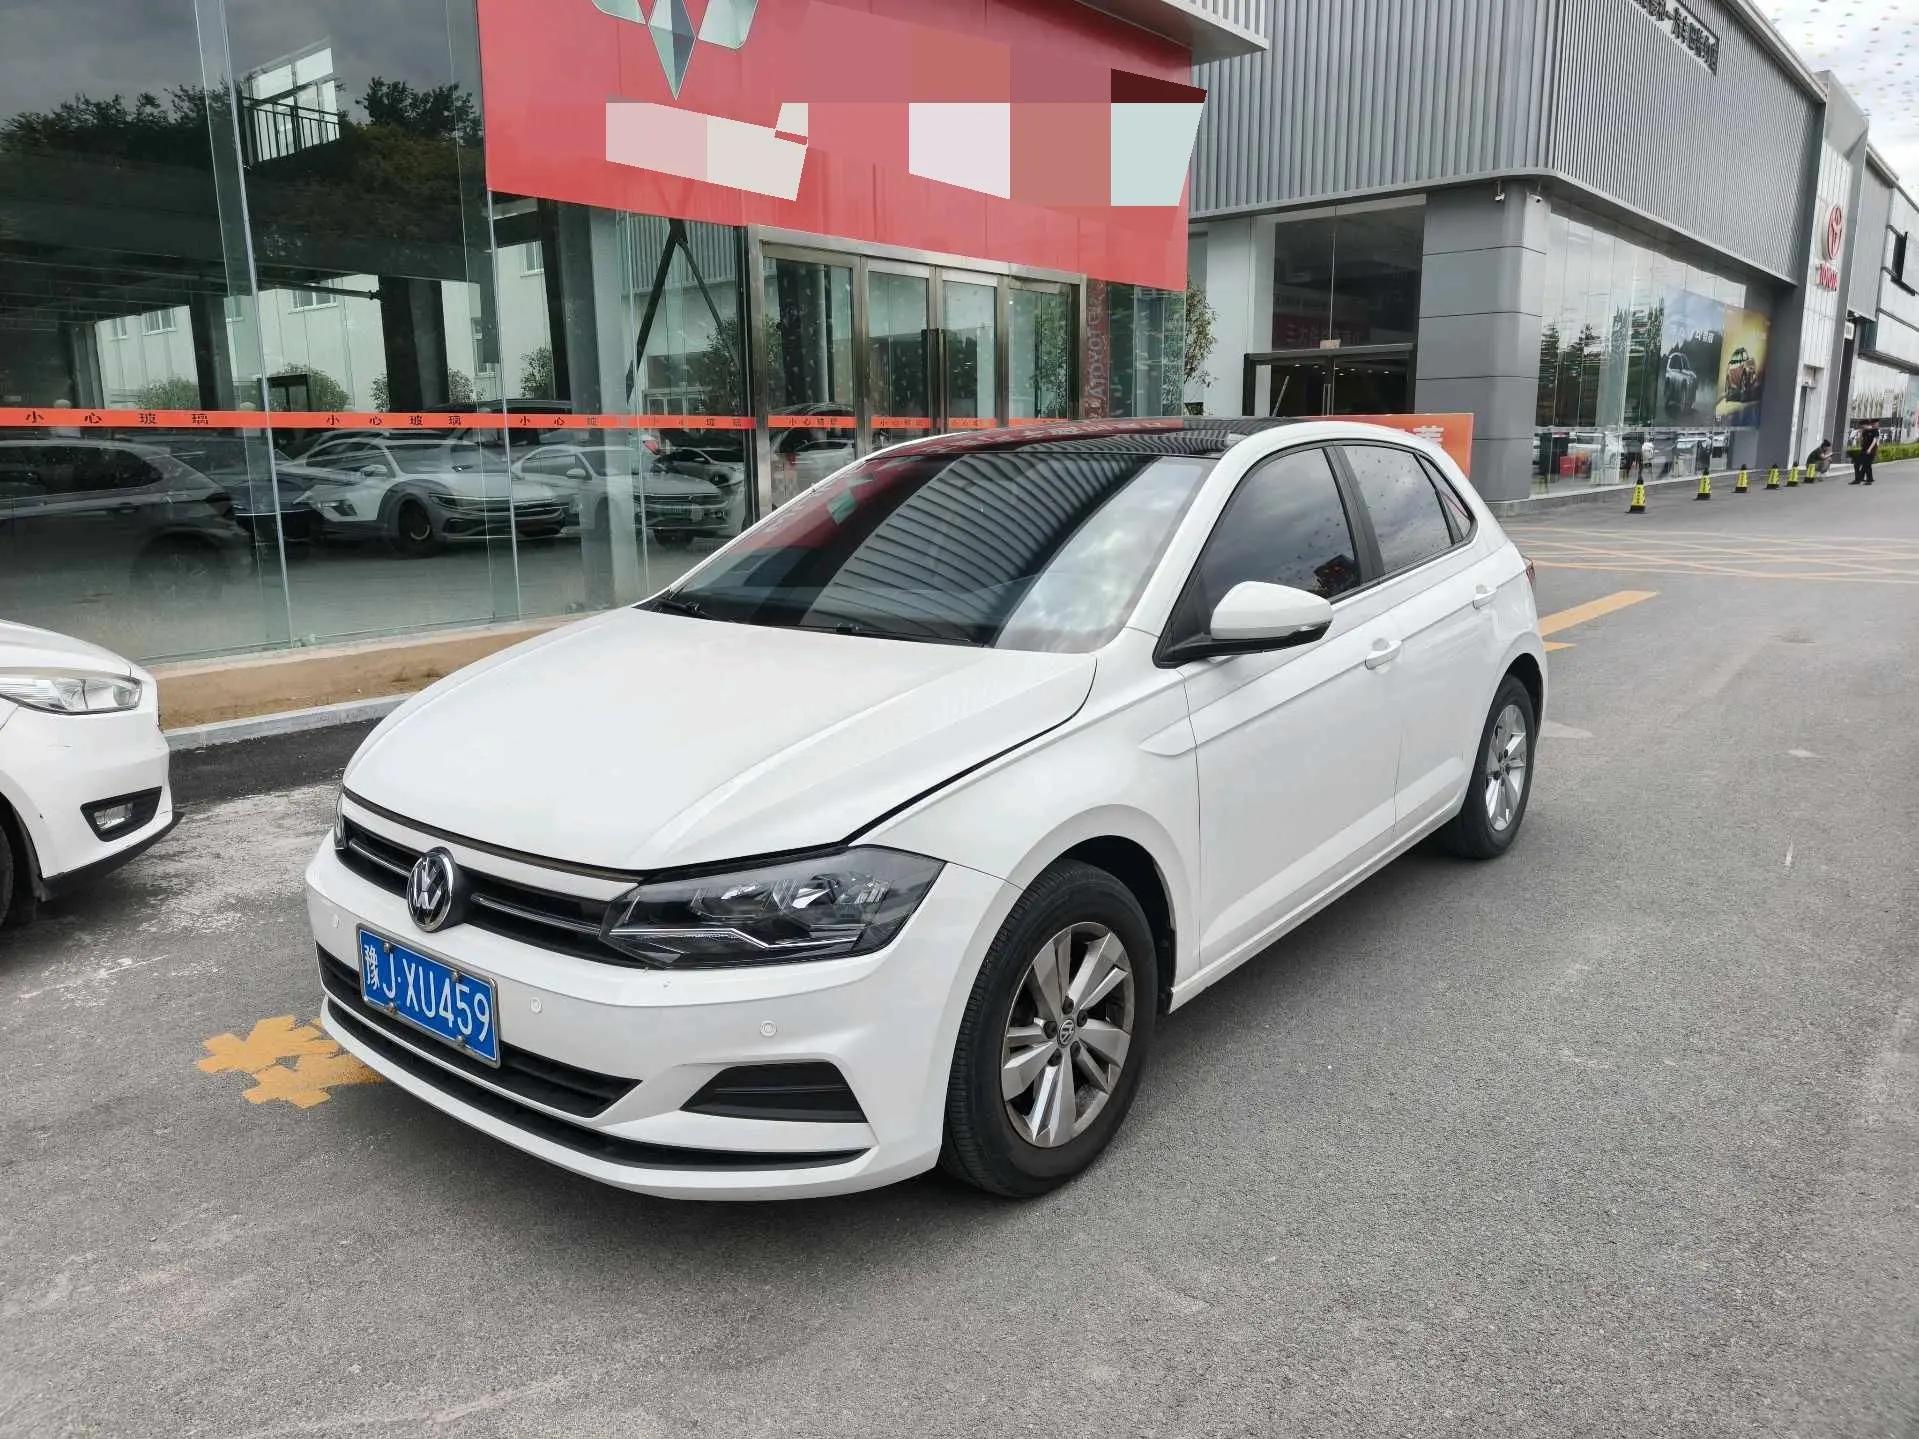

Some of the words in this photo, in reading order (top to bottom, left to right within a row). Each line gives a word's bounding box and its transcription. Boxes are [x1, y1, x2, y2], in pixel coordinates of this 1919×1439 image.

[25, 410, 209, 425] 小心玻璃
[326, 412, 462, 426] 小心玻璃
